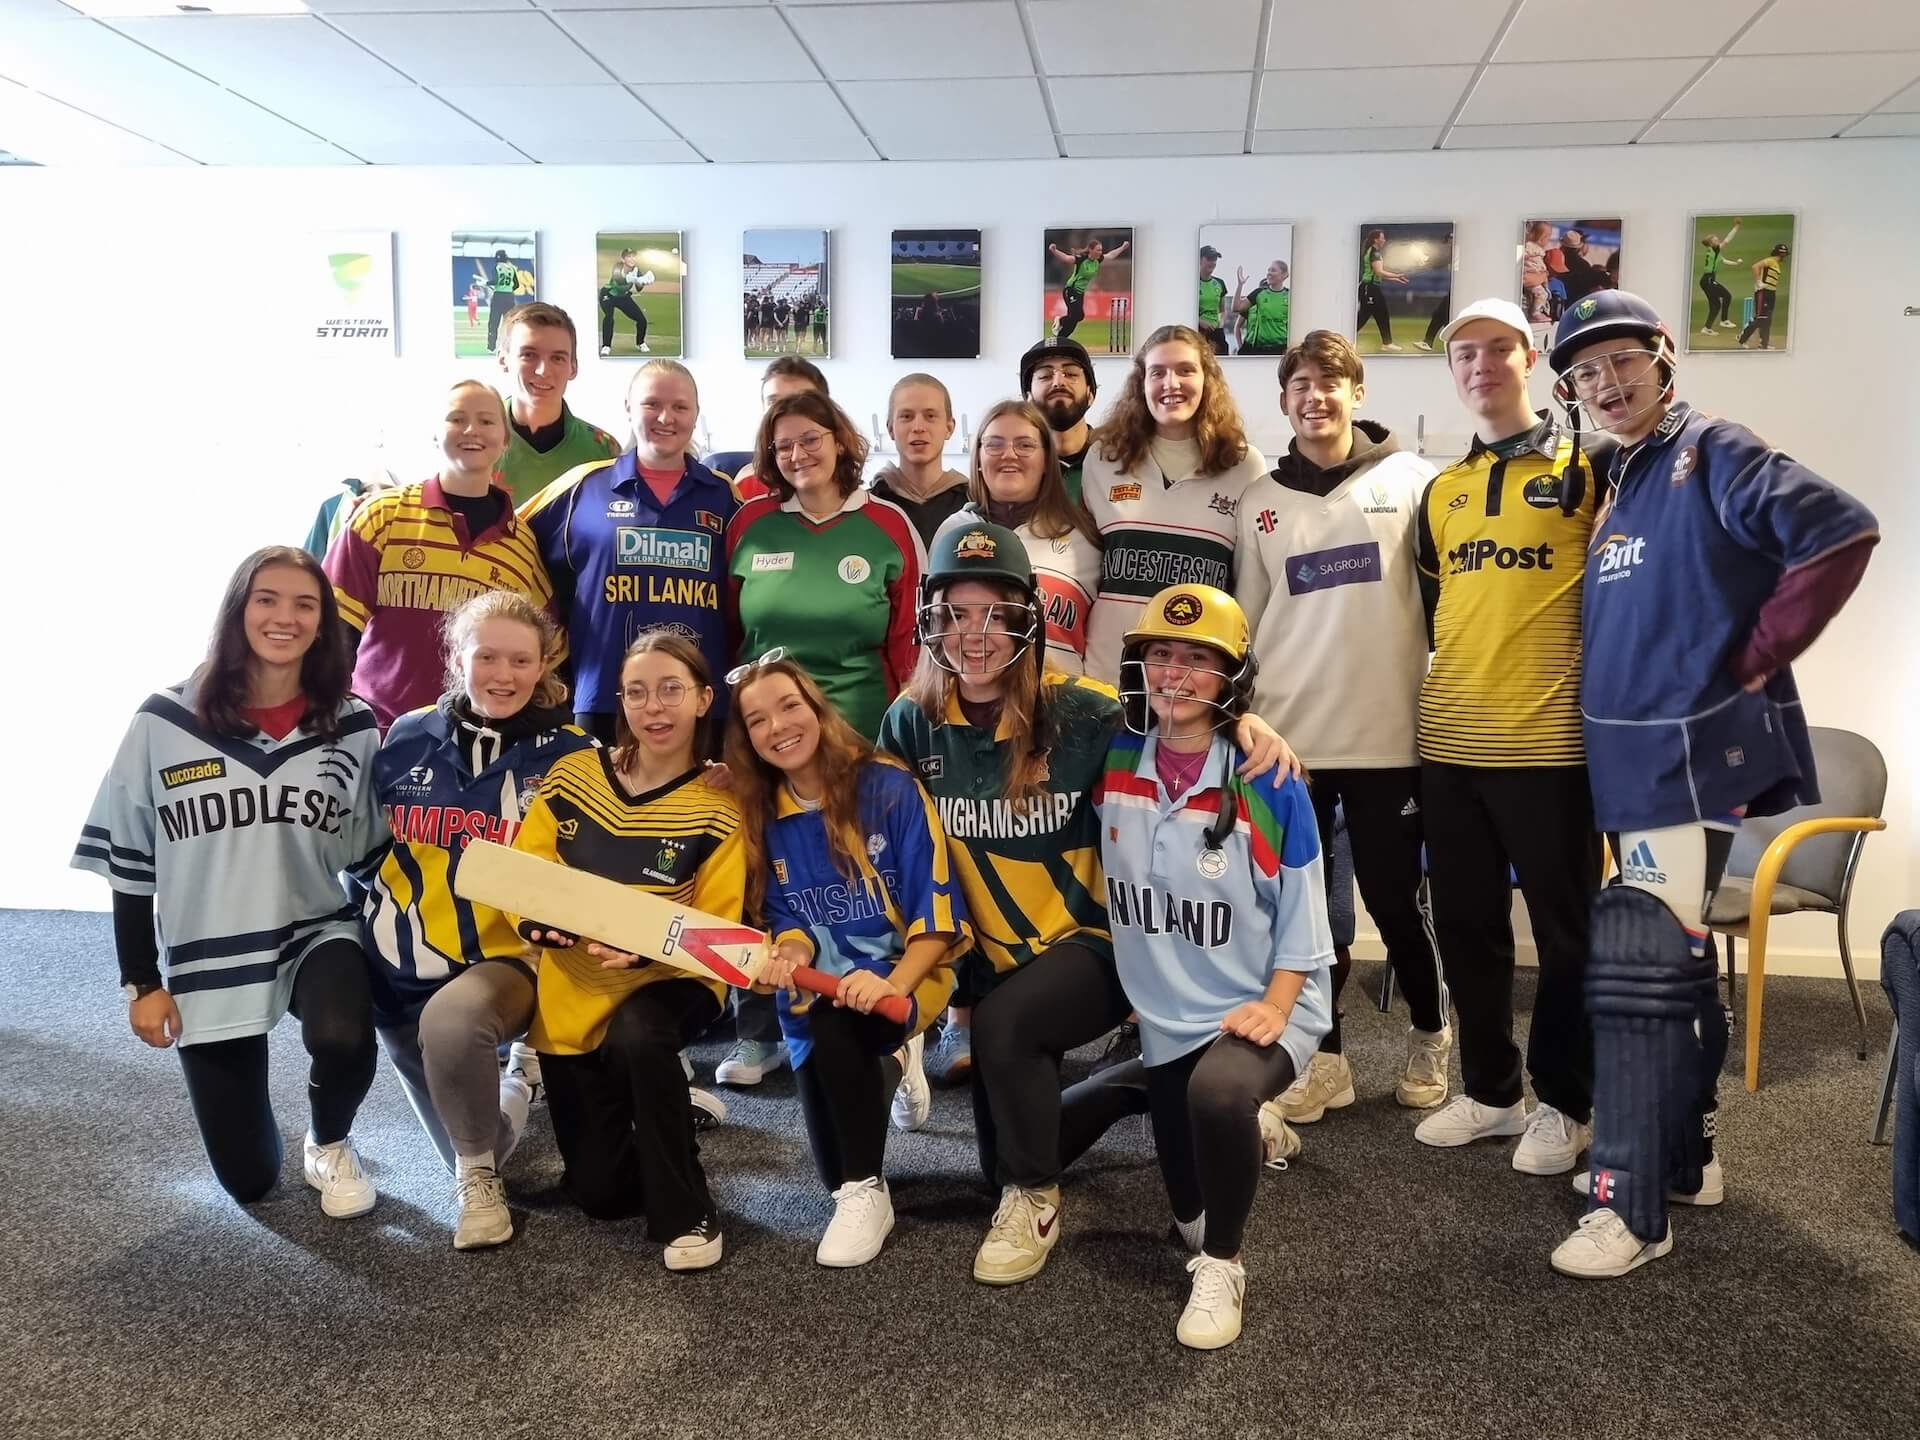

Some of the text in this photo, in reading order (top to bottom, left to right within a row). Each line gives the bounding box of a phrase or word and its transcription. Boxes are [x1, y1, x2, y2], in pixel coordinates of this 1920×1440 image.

[316, 327, 390, 338] STORM
[619, 529, 707, 563] Dilmah
[756, 555, 789, 568] Hyder
[1448, 538, 1554, 575] MiPost
[1599, 536, 1646, 574] Brit
[1319, 556, 1372, 576] SA GROUP
[604, 574, 719, 611] SRI LANKA
[163, 761, 222, 787] Lucozade
[157, 784, 353, 843] MIDDLESEX
[662, 914, 685, 957] 100
